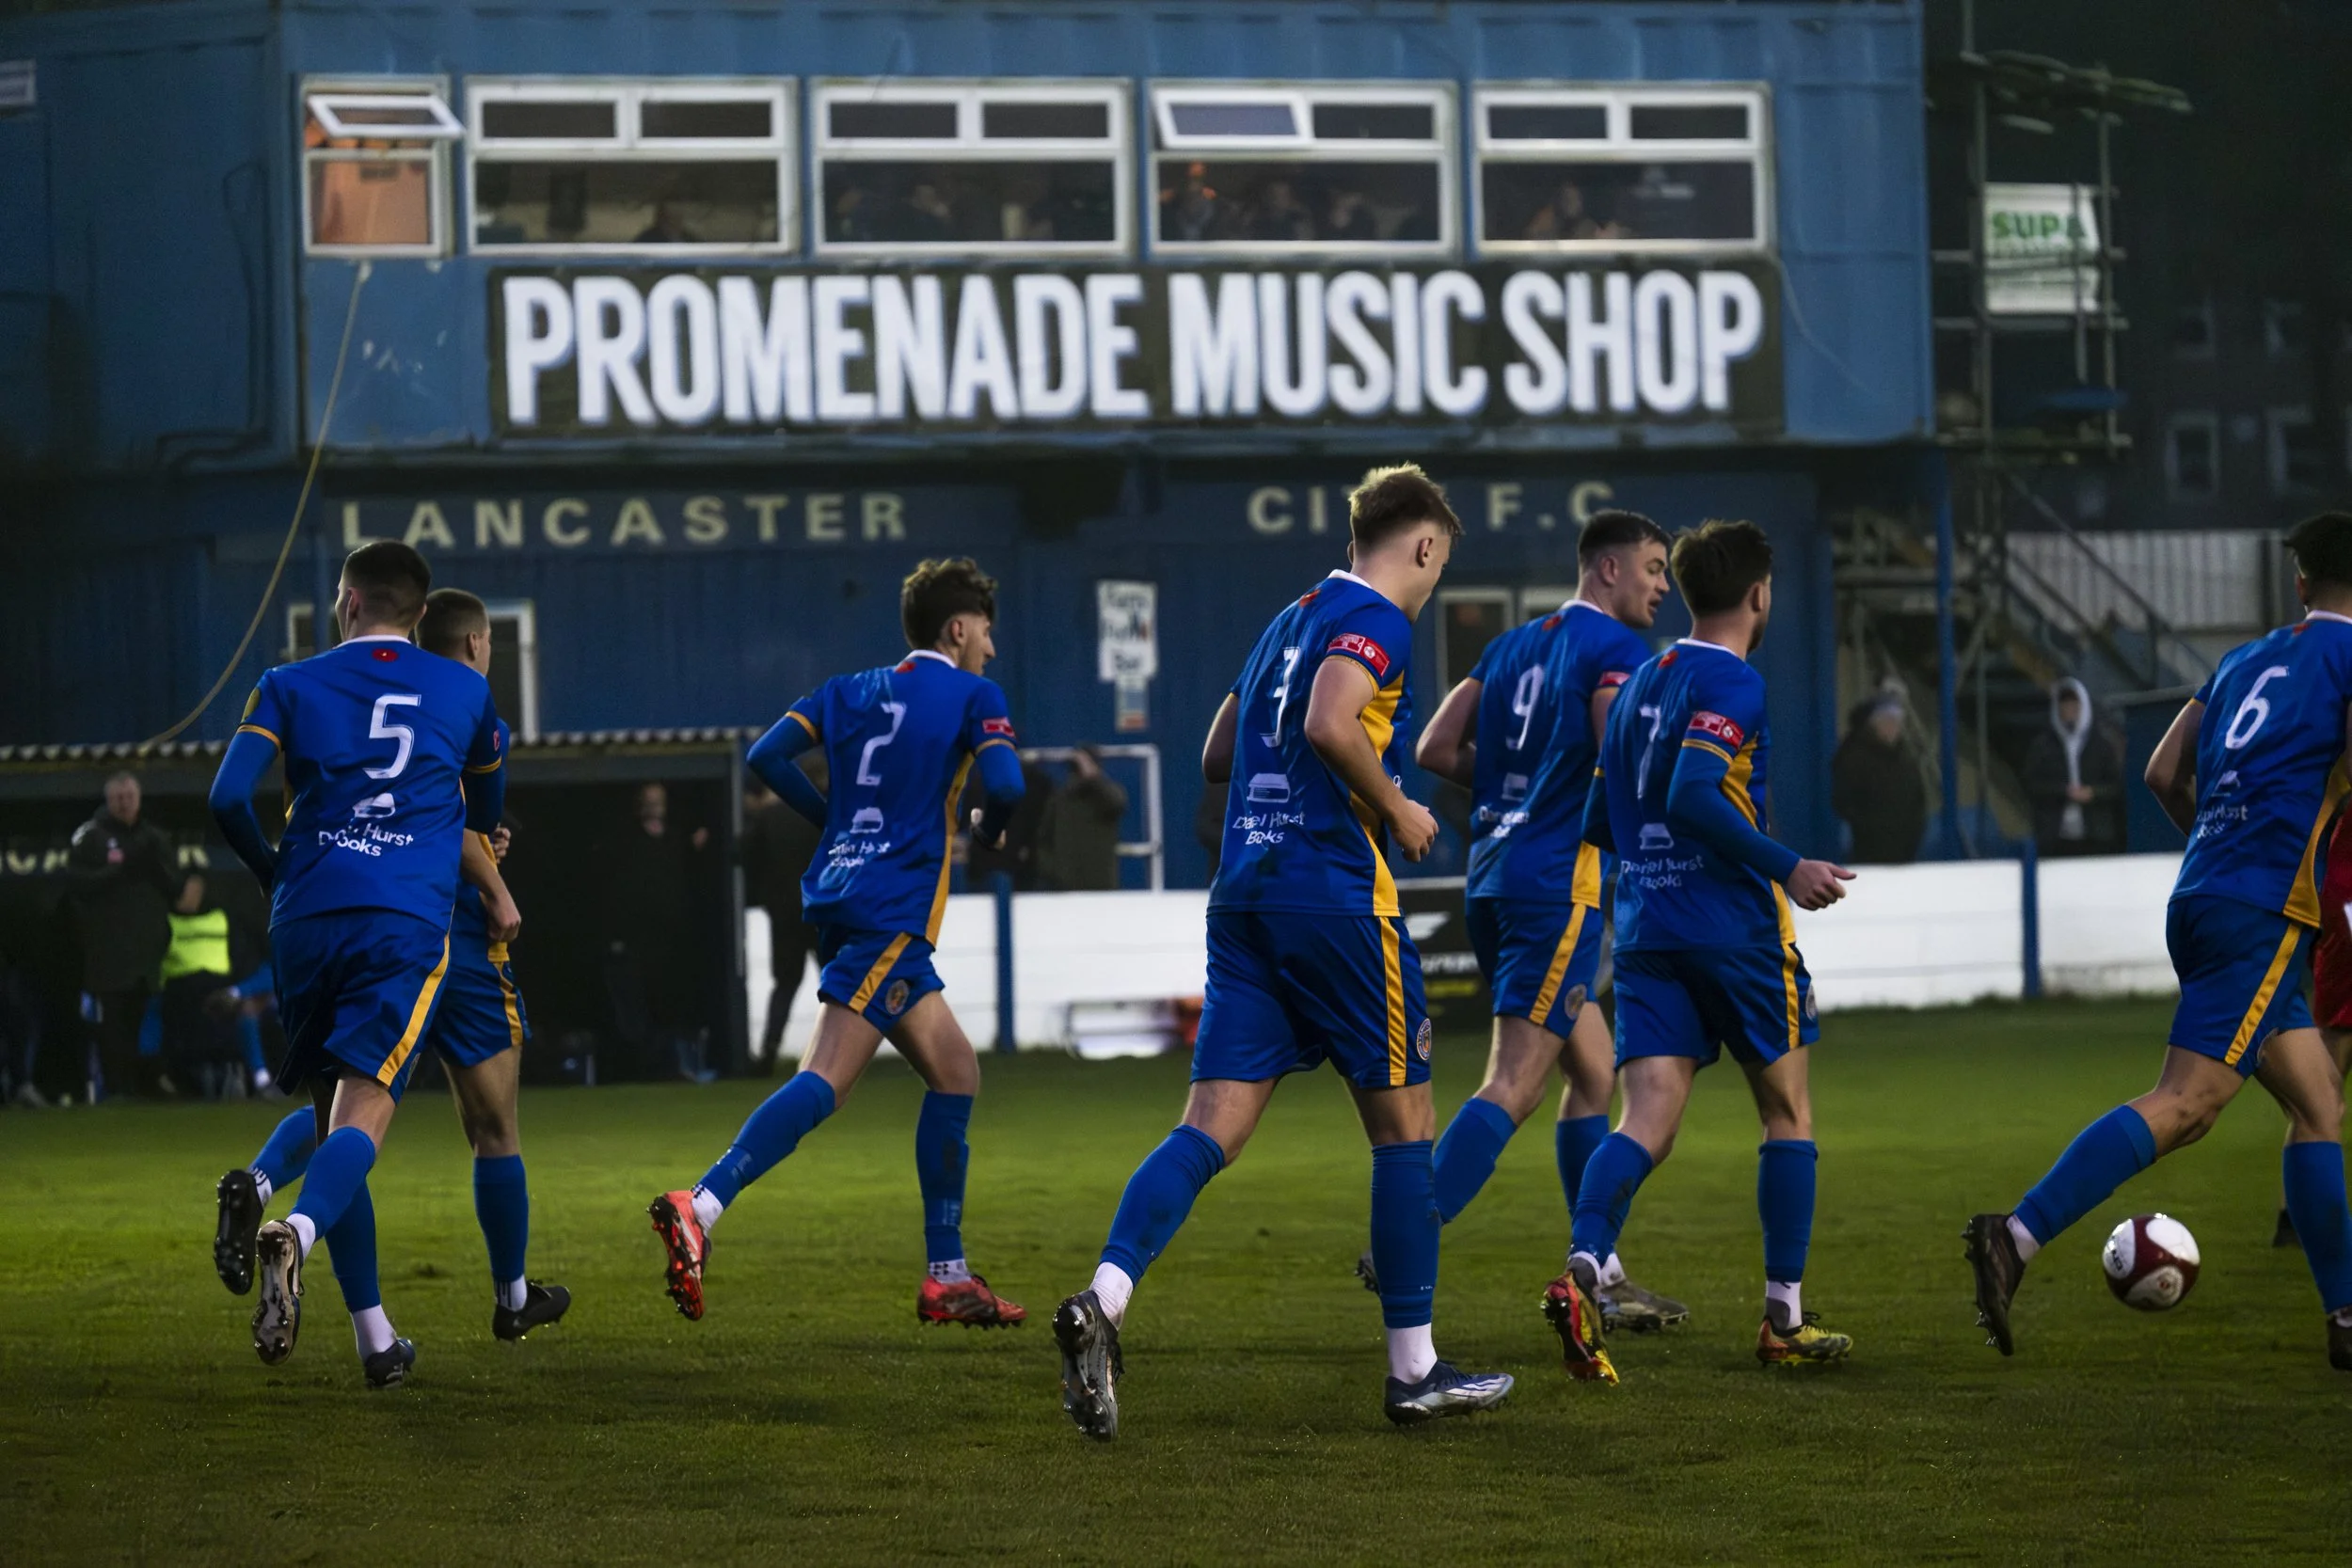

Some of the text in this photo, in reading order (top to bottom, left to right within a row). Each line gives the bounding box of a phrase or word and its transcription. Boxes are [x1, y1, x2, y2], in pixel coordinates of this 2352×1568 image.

[503, 269, 1764, 425] PROMENADE MUSIC SHOP
[342, 495, 907, 549] LANCASTER
[363, 694, 421, 779] 5
[855, 702, 907, 786] 2
[1506, 664, 1545, 751] 9
[2225, 665, 2289, 750] 6
[1637, 704, 1661, 800] 7
[336, 834, 382, 857] ooks
[363, 823, 414, 847] Hurst
[1245, 830, 1285, 845] Boks
